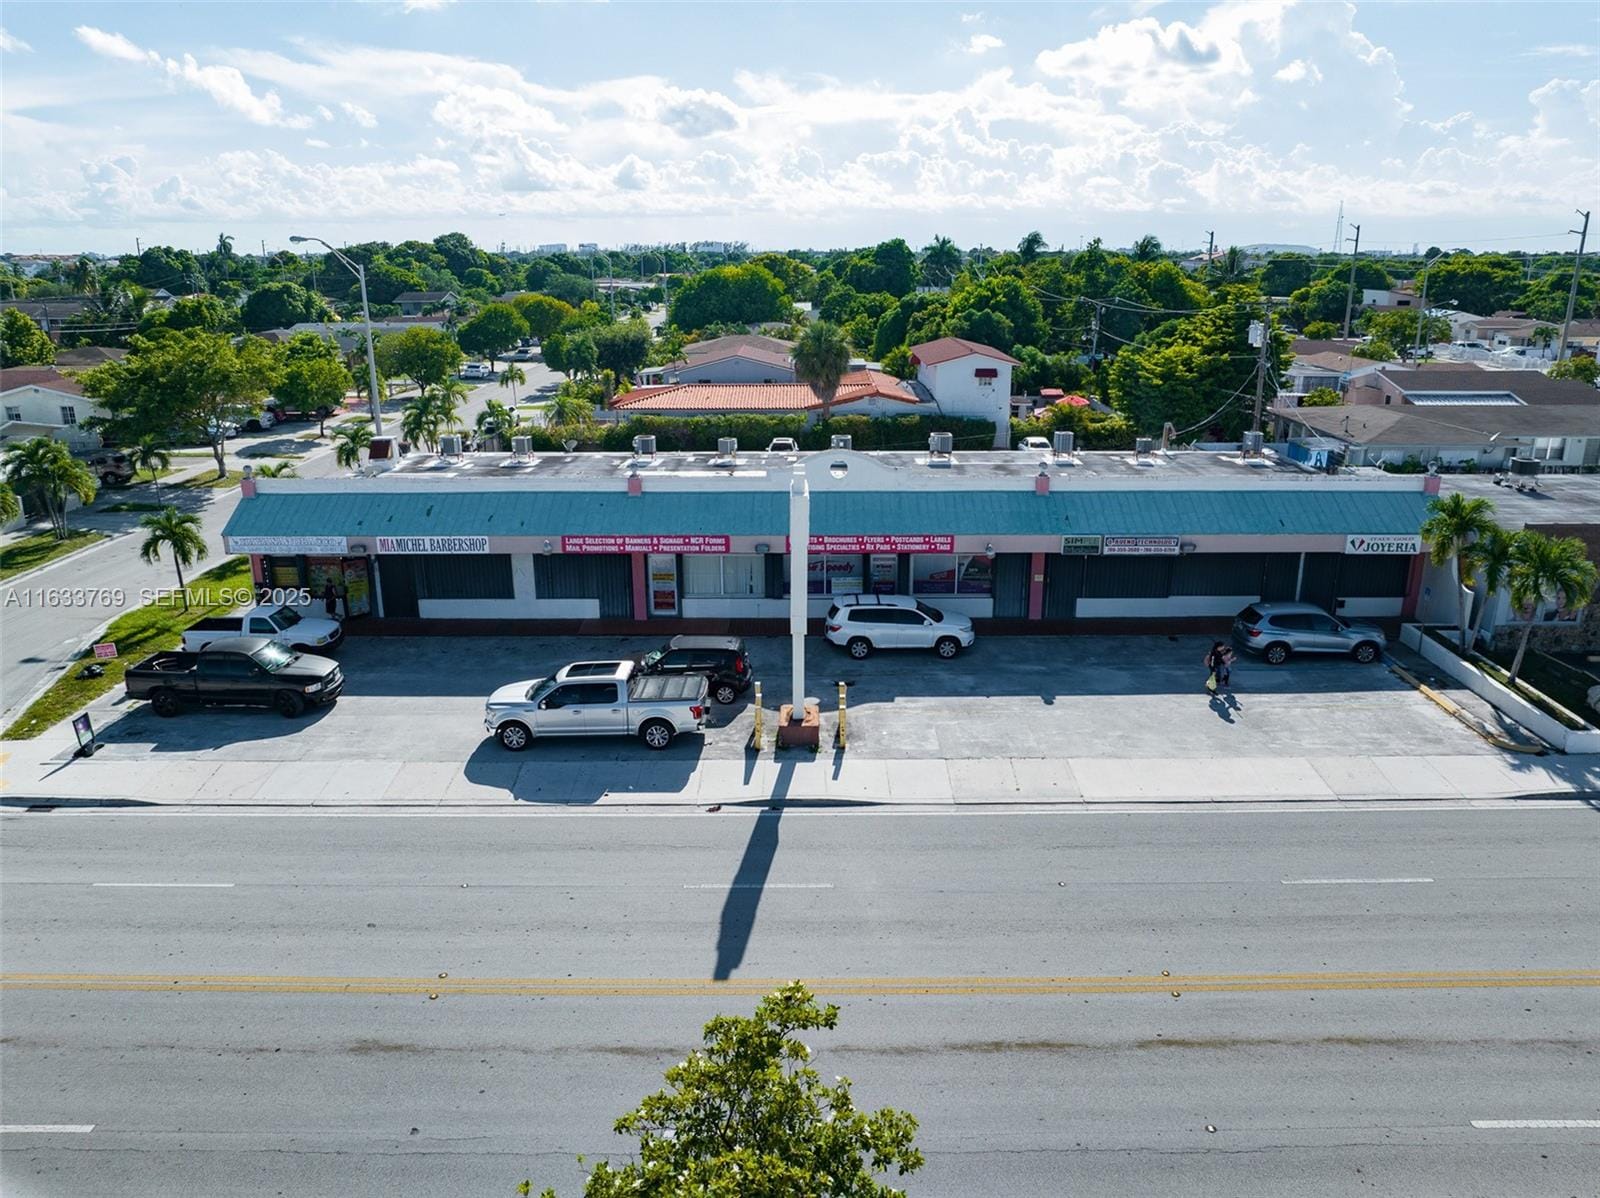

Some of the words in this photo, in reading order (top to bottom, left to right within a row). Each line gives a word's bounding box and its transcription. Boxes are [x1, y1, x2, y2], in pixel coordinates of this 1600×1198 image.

[379, 538, 428, 552] MIAMICHEL
[430, 537, 488, 552] BARBERSHOP
[1363, 542, 1417, 552] JOYERIA
